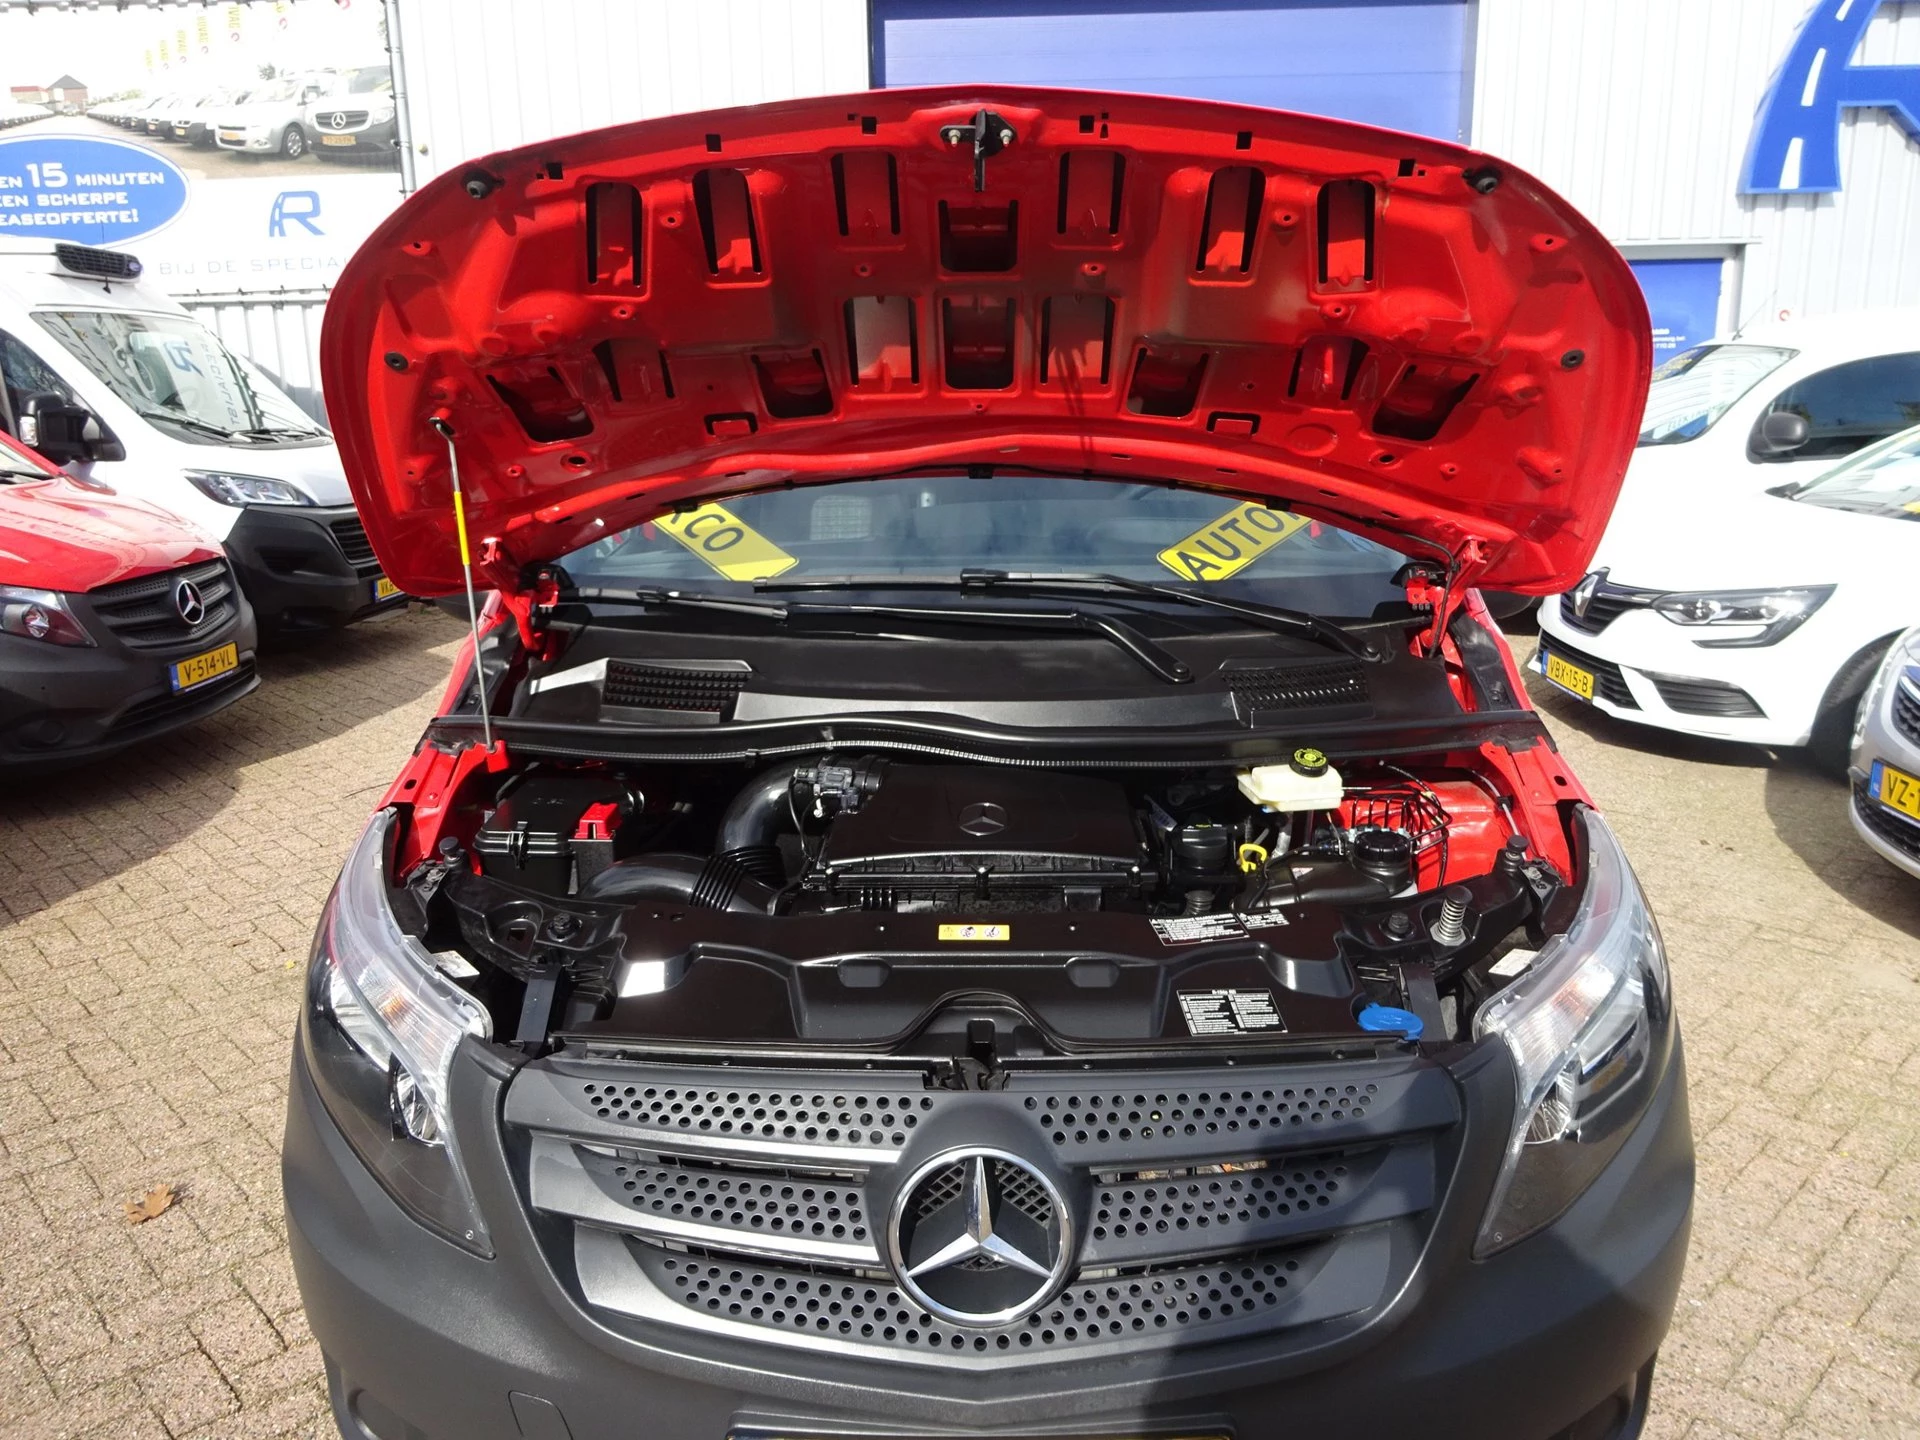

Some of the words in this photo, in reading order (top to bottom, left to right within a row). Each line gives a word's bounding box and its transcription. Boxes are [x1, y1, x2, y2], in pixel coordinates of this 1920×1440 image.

[26, 163, 68, 188] 15
[75, 172, 165, 187] MINUTEN
[37, 192, 129, 207] SCHERPE
[0, 208, 139, 227] EASEOFFERTE!
[159, 262, 195, 275] BIJ
[207, 260, 237, 273] DE
[1176, 506, 1300, 581] AUTO
[184, 649, 232, 681] V-514-VL
[1551, 657, 1588, 693] VBX-15-B
[1888, 772, 1920, 814] VZ-
